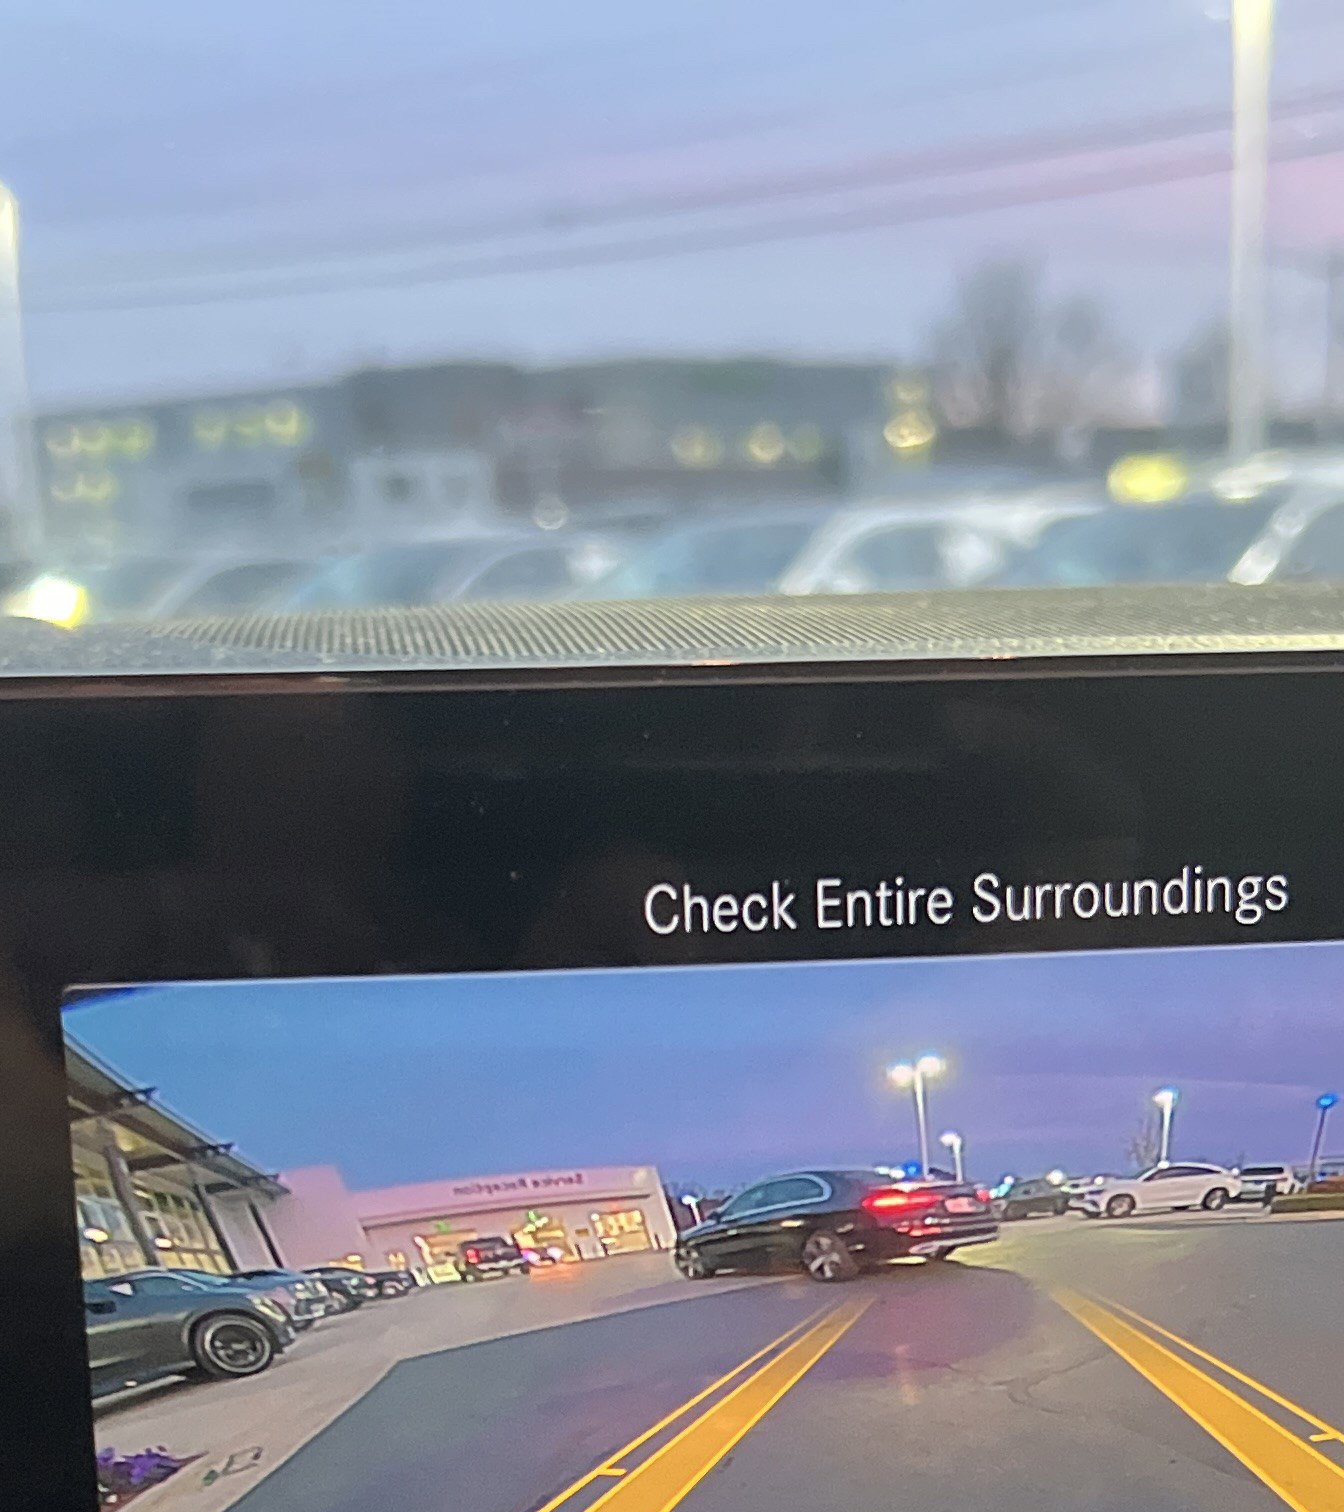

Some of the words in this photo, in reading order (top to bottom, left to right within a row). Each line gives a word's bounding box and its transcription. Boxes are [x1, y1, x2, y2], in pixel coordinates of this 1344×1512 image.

[644, 881, 798, 936] Check
[816, 876, 954, 930] Entire
[971, 865, 1289, 926] Surroundings
